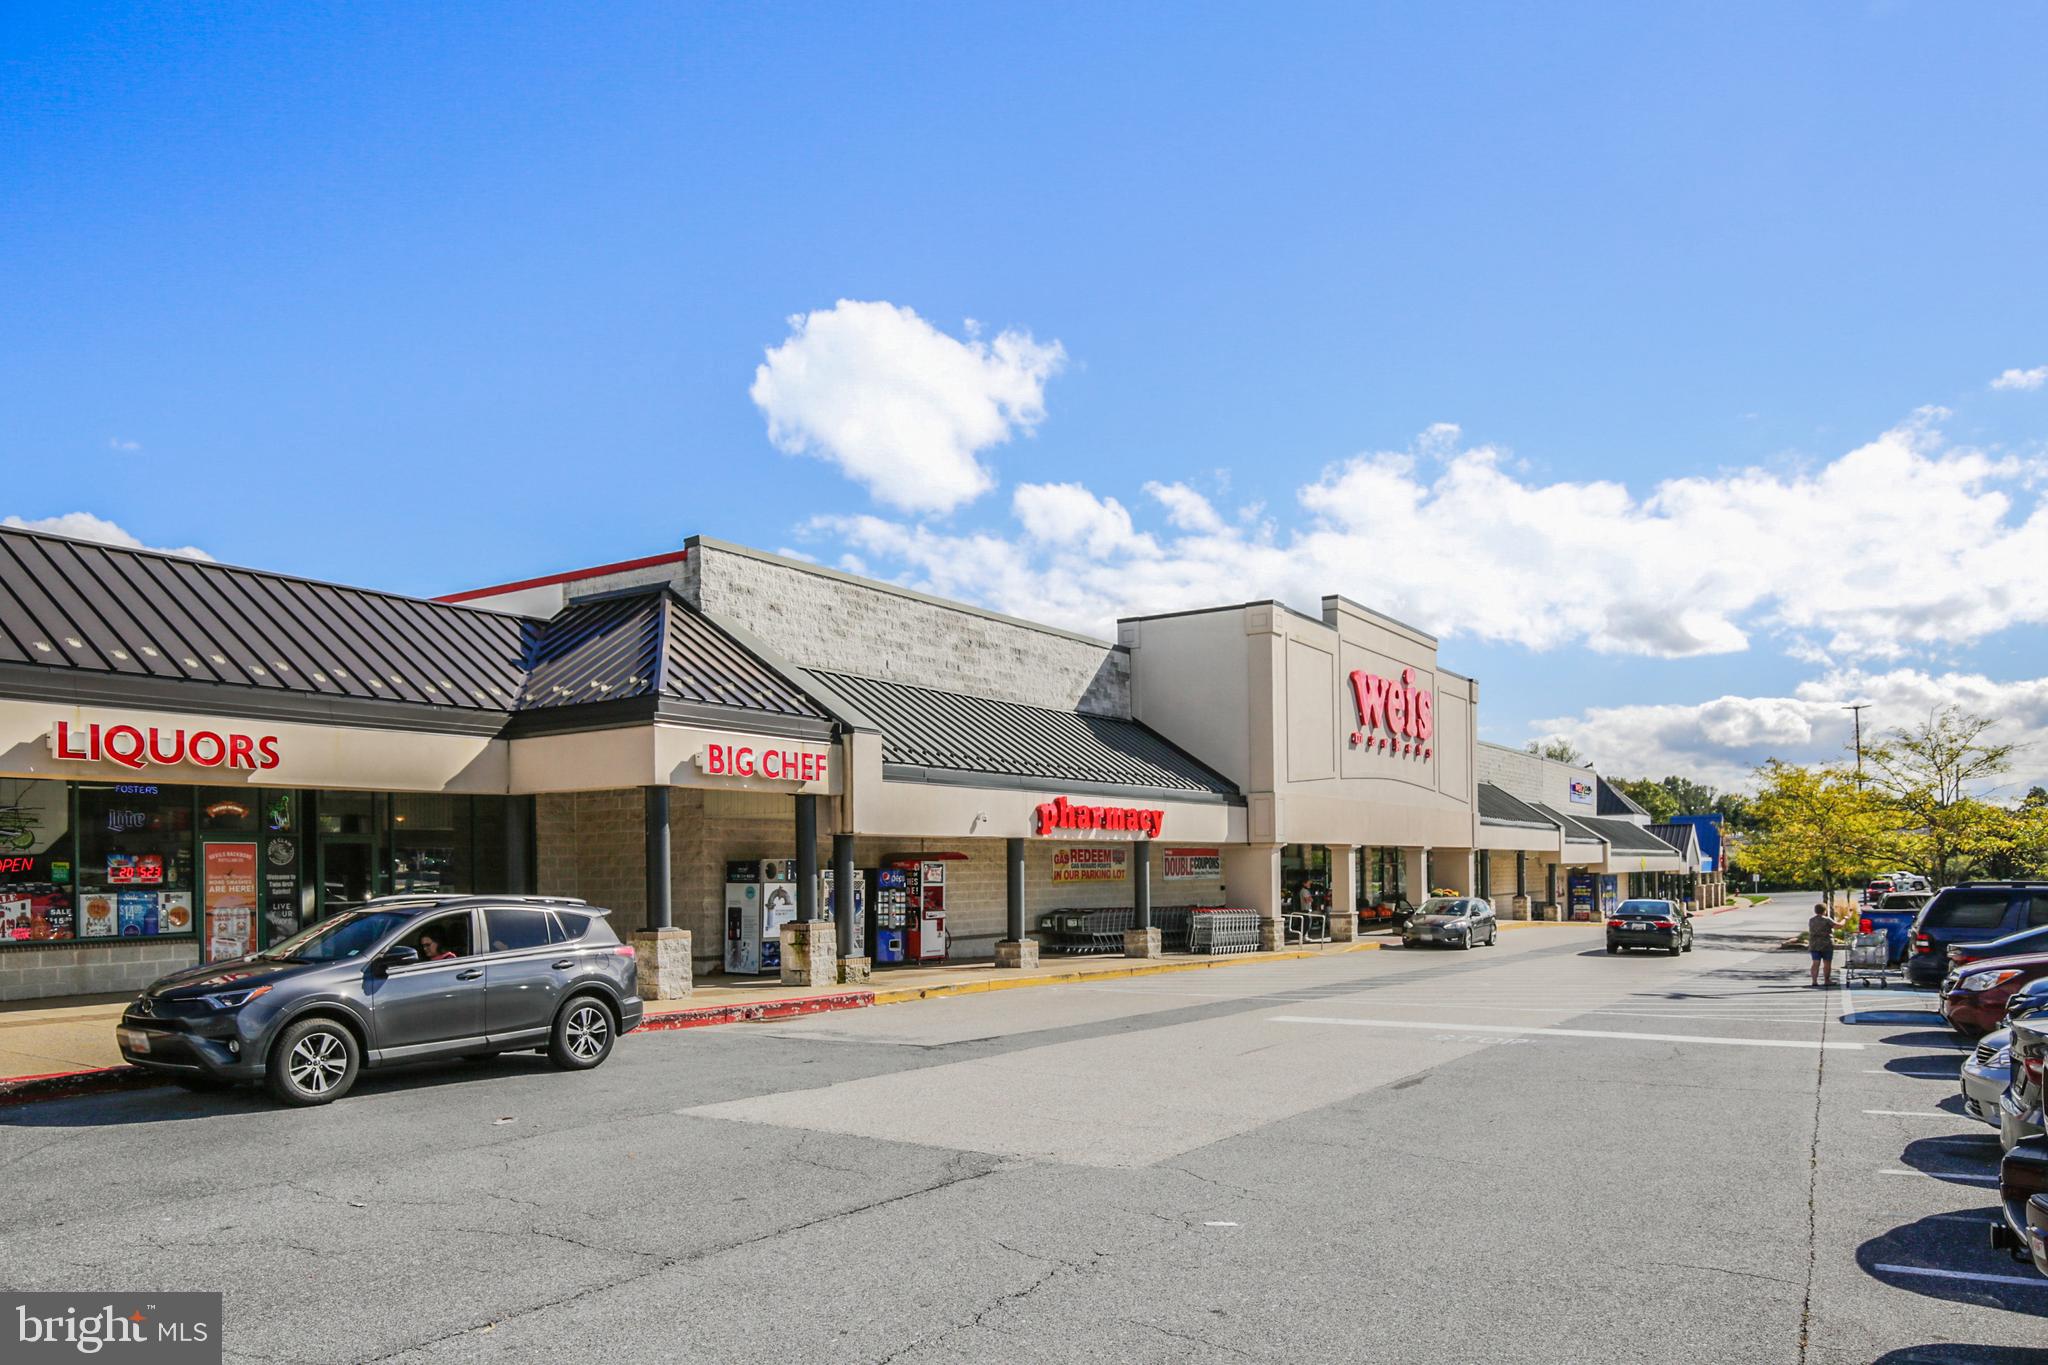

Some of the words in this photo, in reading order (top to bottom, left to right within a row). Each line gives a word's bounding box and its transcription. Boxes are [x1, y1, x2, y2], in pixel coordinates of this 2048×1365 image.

[55, 720, 281, 770] LIQUORS
[707, 743, 755, 777] BIG
[762, 749, 828, 782] CHEF
[1036, 796, 1165, 839] pharmacy
[1070, 848, 1112, 863] REDEEM
[0, 857, 33, 872] PEN
[120, 867, 134, 877] 20
[1165, 857, 1194, 876] DOUBLE
[1194, 857, 1220, 870] COUPONS
[1054, 870, 1062, 880] IN
[1063, 869, 1080, 880] OUR
[1081, 869, 1112, 880] PARKING
[1113, 869, 1126, 880] LOT
[229, 885, 256, 893] HERE!
[273, 903, 291, 911] LIVE
